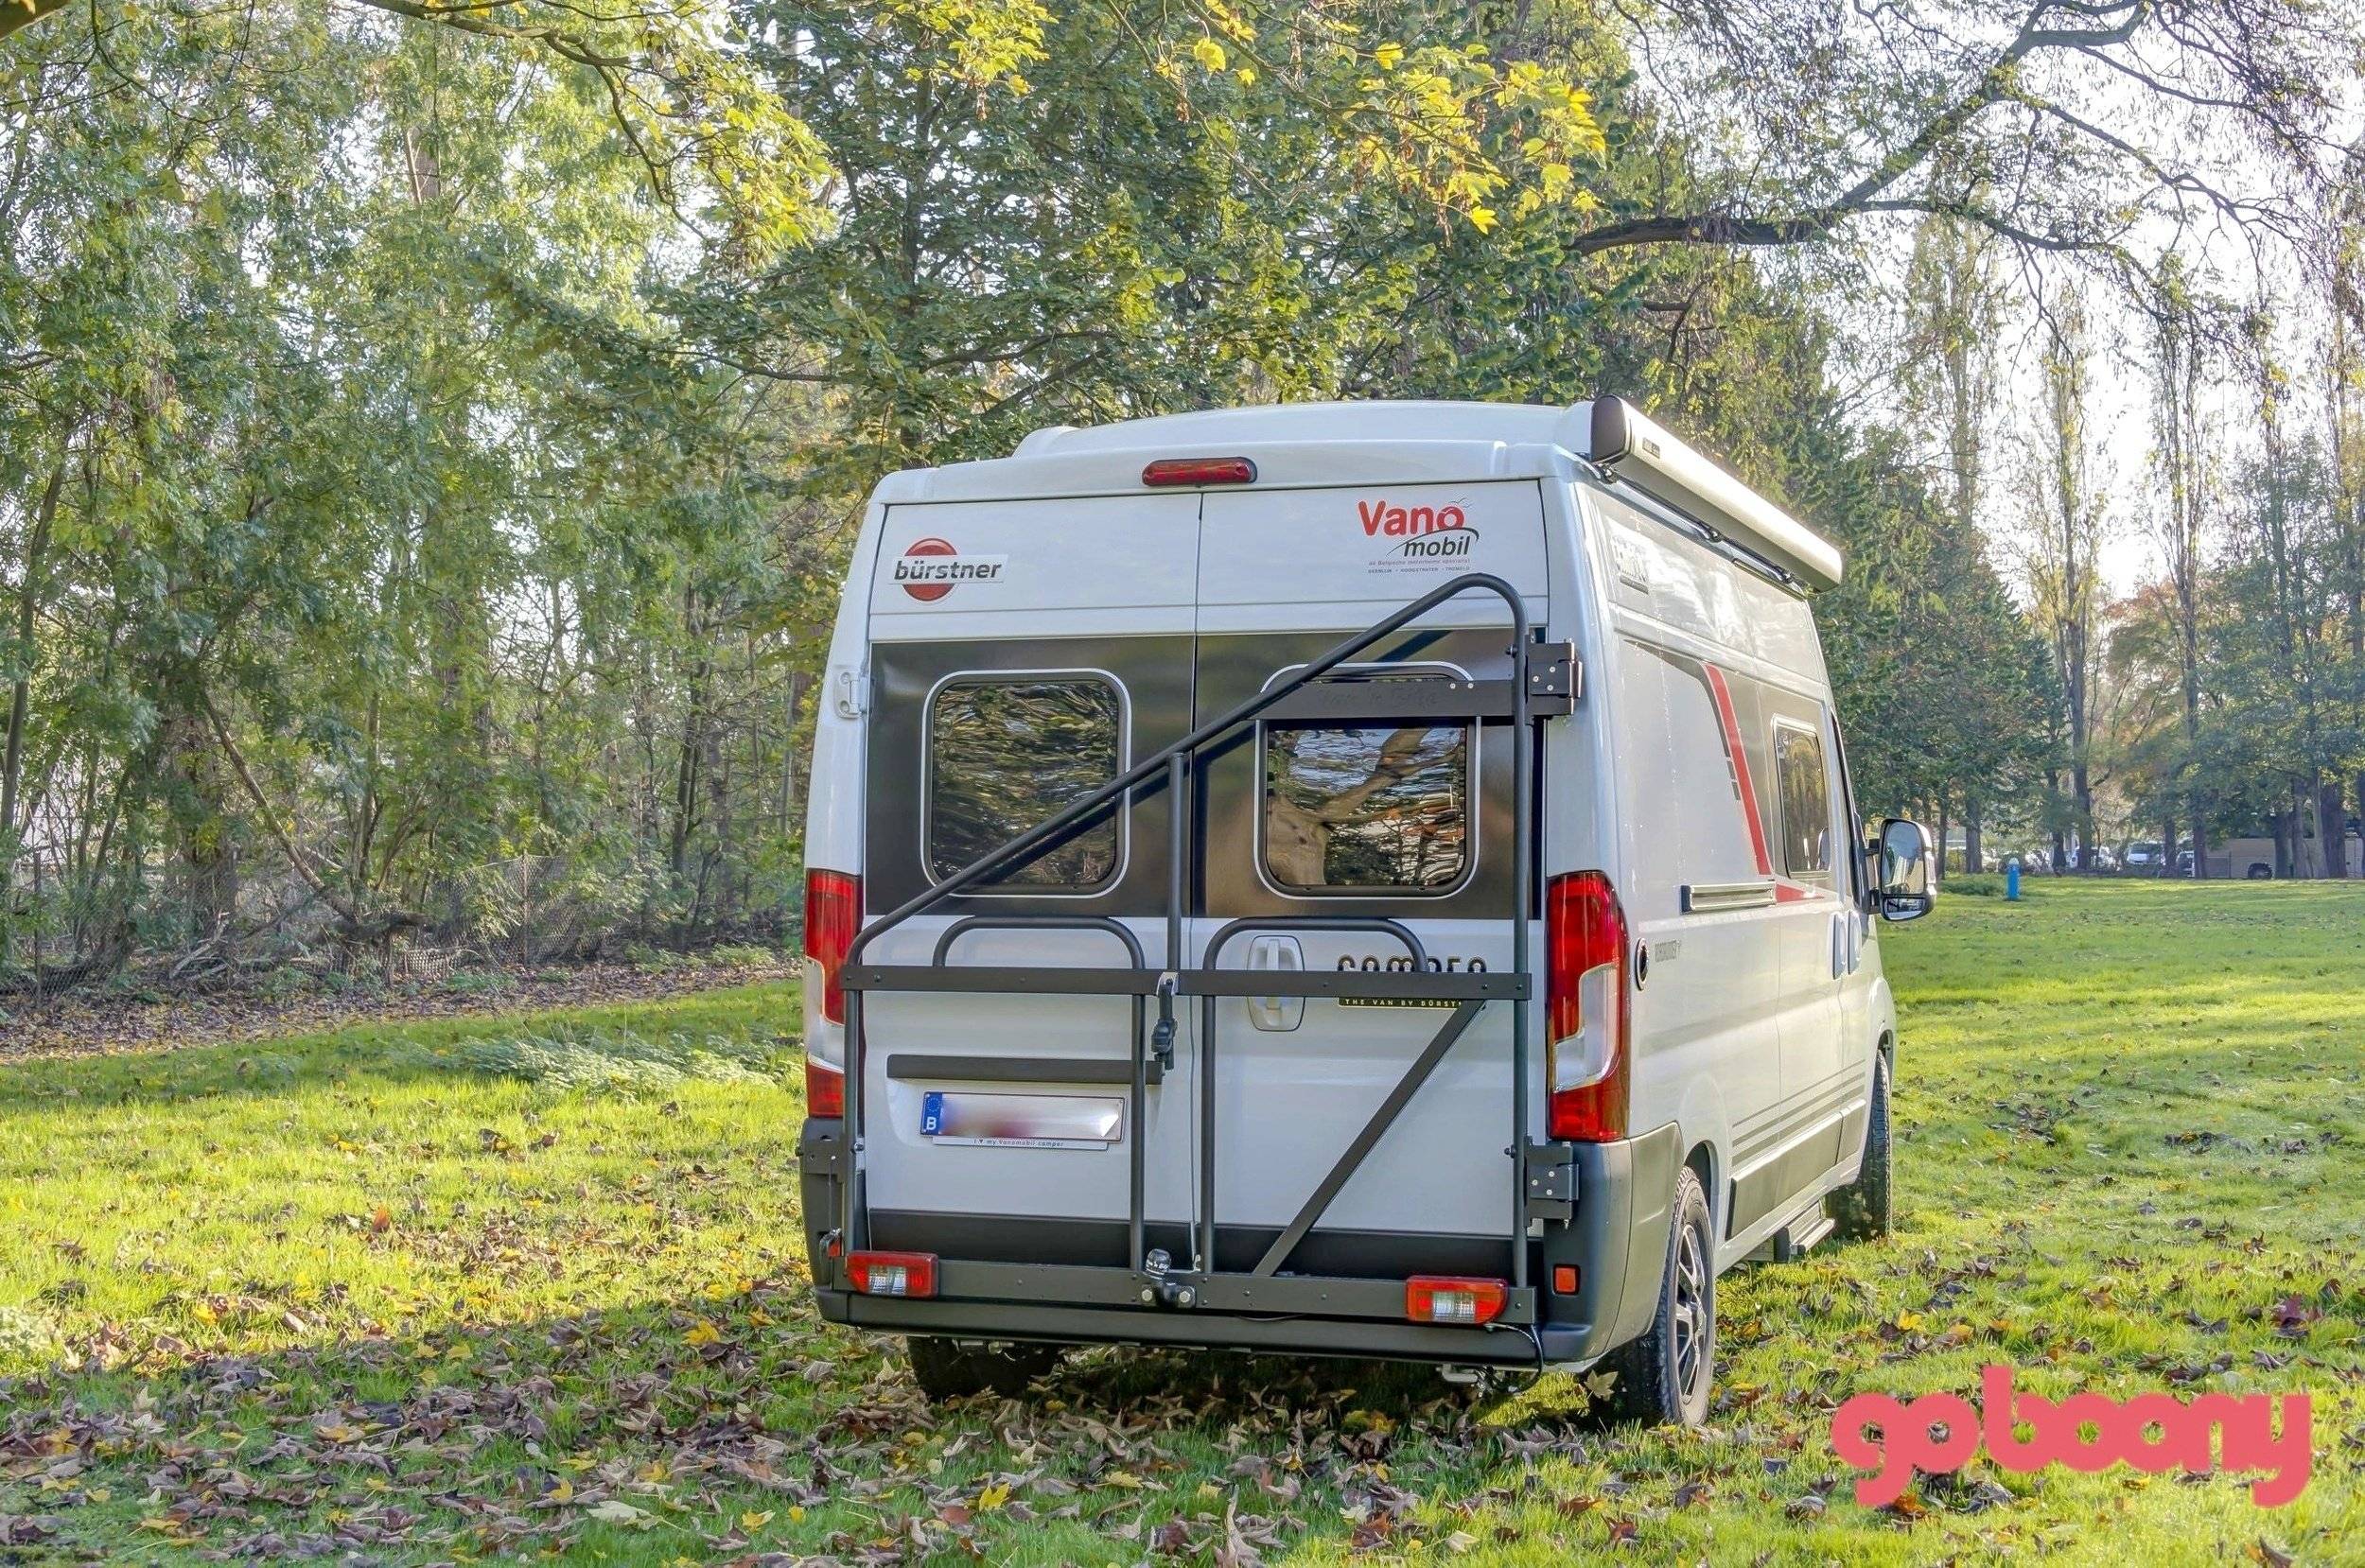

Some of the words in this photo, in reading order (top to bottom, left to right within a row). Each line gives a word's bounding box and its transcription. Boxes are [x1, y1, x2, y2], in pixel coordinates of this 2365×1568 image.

[1358, 500, 1465, 536] Vano
[1403, 535, 1471, 557] mobil
[893, 560, 1003, 581] bürstner
[925, 1116, 937, 1131] B
